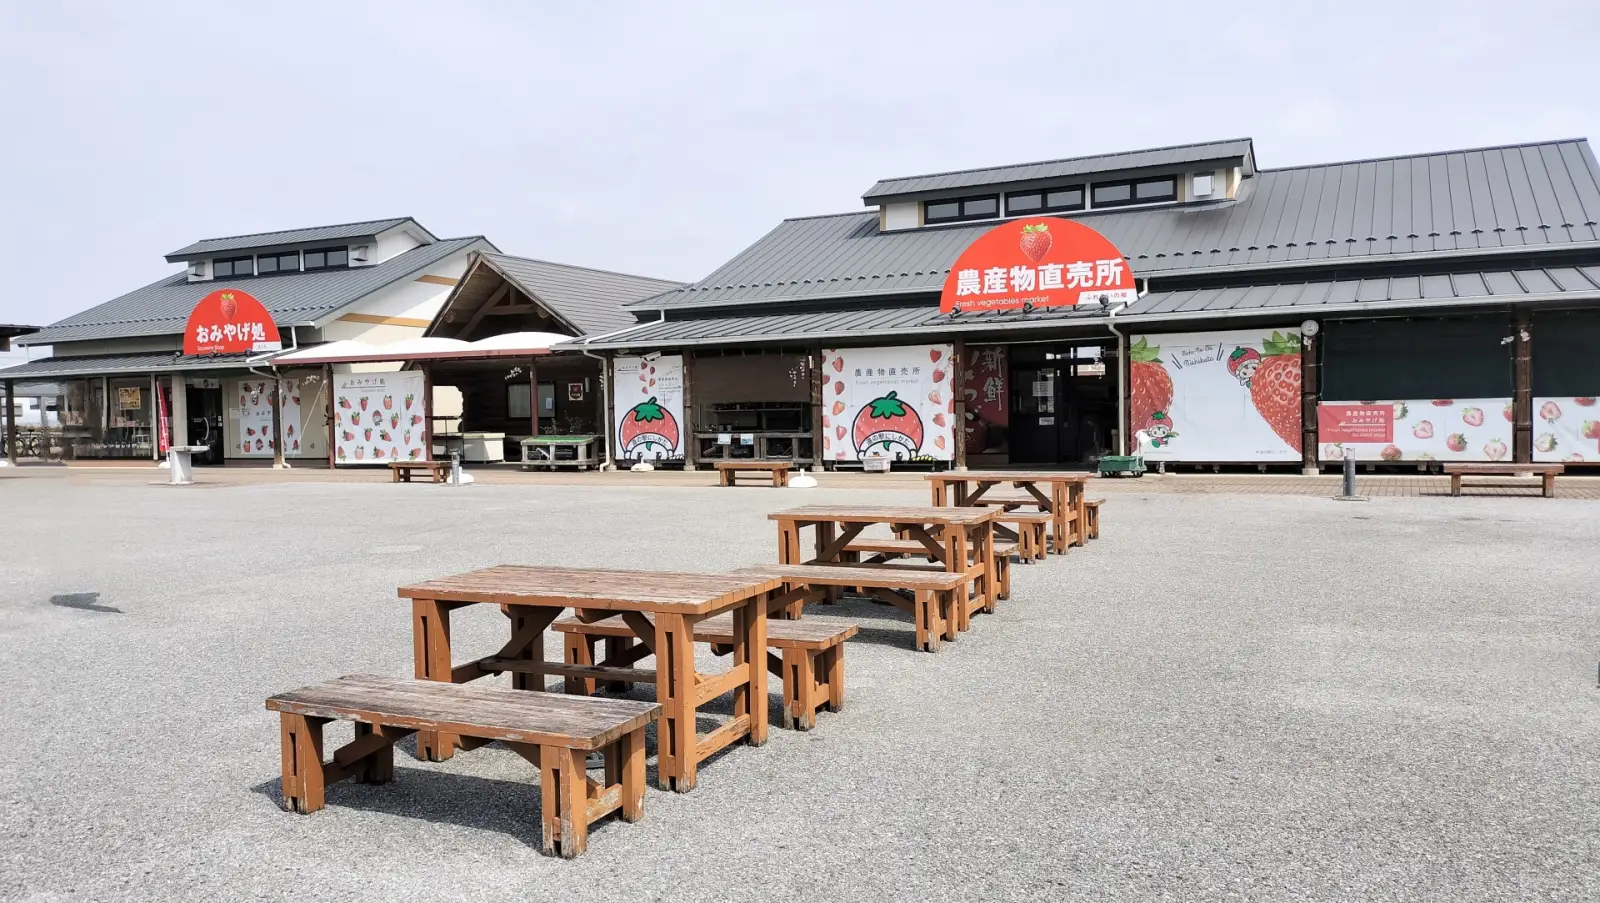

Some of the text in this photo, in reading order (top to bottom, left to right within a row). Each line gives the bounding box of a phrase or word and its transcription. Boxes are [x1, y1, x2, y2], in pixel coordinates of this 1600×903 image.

[956, 257, 1124, 296] 農産物直売所
[1087, 291, 1128, 300] ふれいの郷
[955, 300, 976, 308] Fresh
[977, 298, 1020, 307] vegetables
[196, 322, 266, 343] おみやげ処
[854, 366, 921, 378] 農産物直売所
[349, 378, 386, 386] おみやげ処
[982, 346, 1005, 412] 新鮮
[631, 434, 668, 446] 道の駅にしかた
[866, 432, 910, 446] 道の駅にしかた
